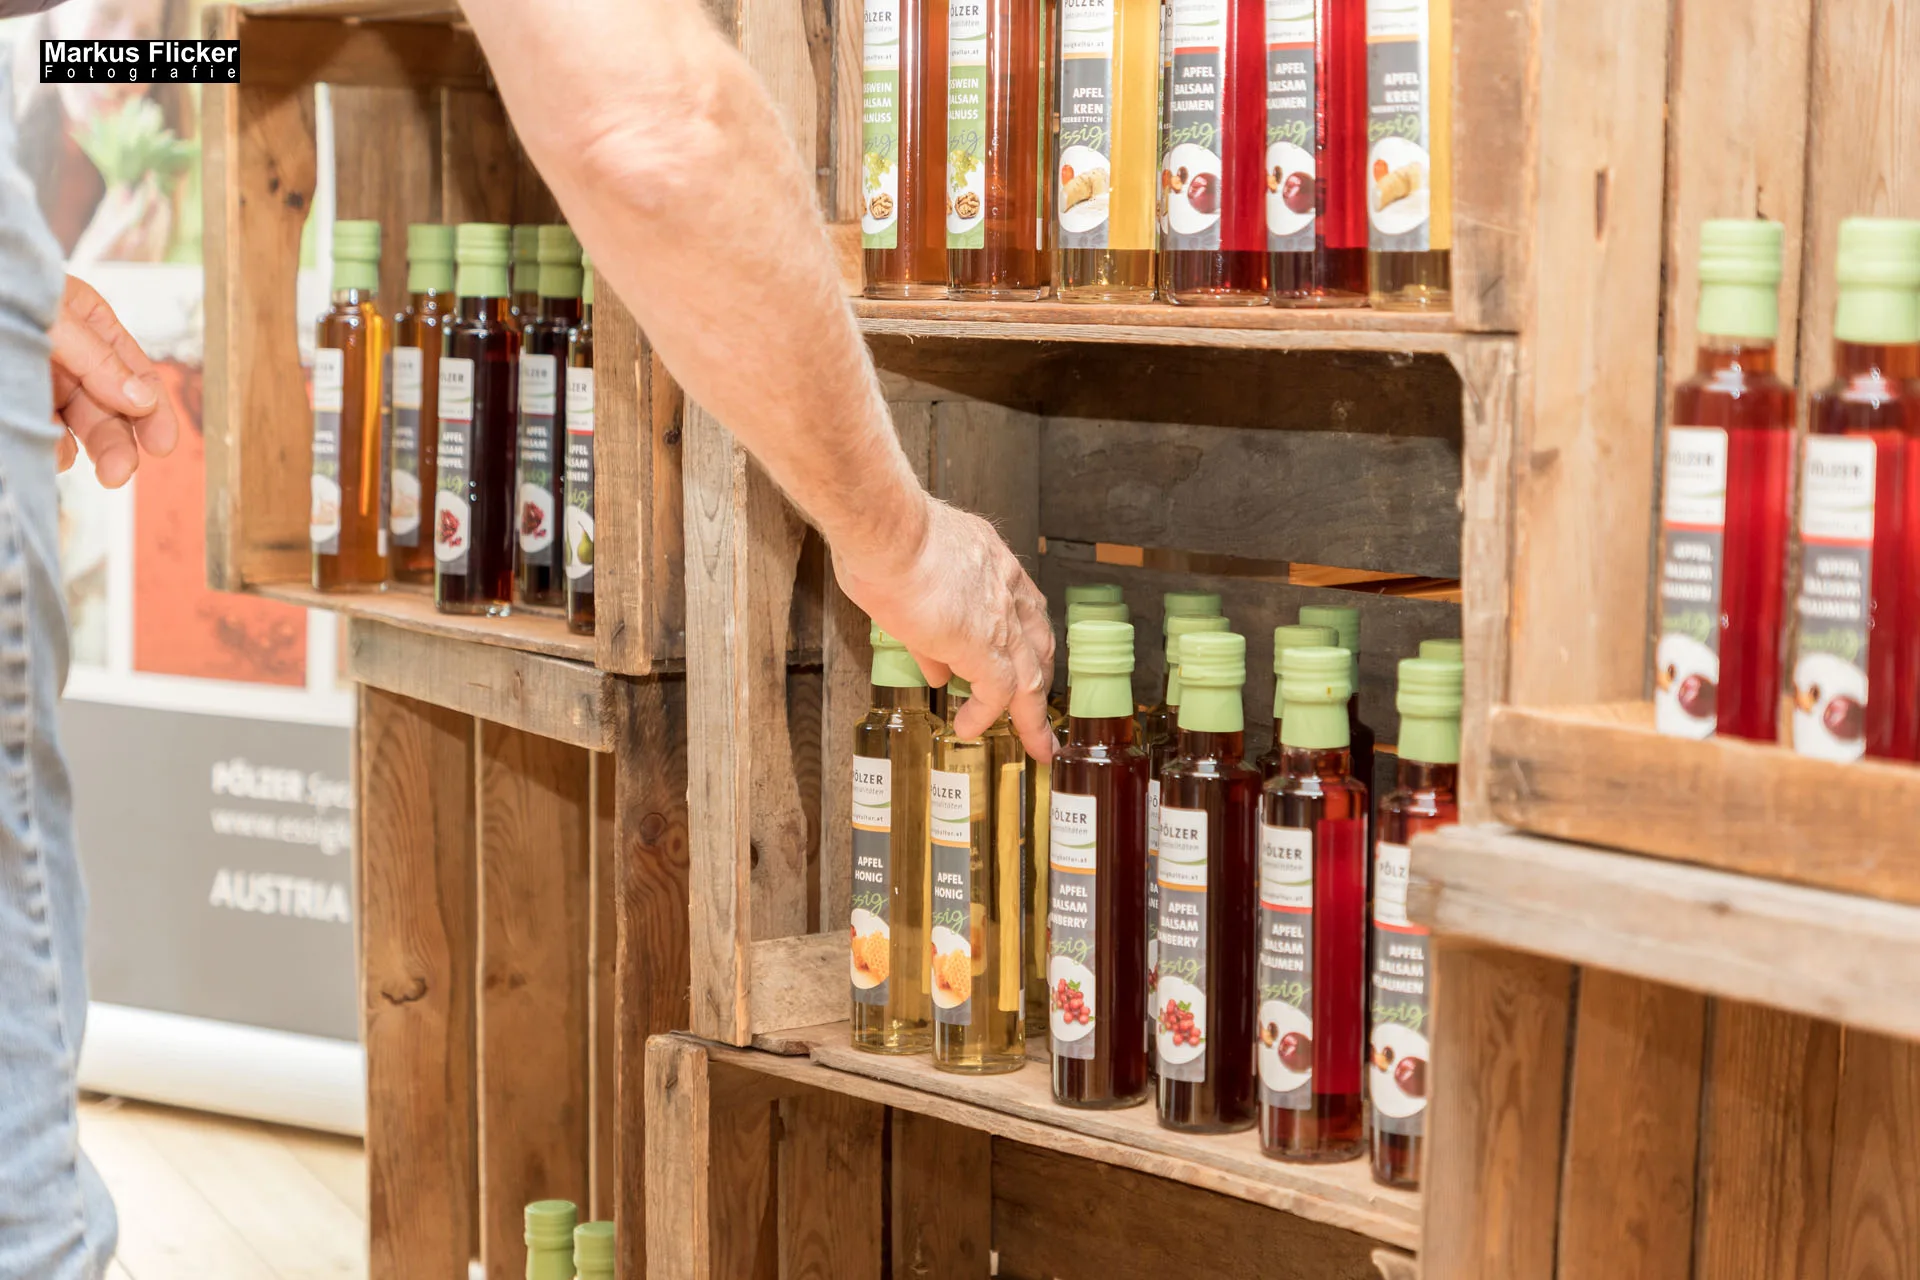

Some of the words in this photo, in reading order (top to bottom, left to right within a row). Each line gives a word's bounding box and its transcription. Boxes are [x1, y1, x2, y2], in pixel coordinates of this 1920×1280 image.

[1183, 66, 1215, 78] APFEL
[1275, 62, 1307, 75] APFEL
[1384, 72, 1419, 86] APFEL
[1072, 87, 1105, 99] APFEL
[1174, 83, 1215, 95] BALSAM
[1386, 91, 1419, 104] KREN
[1073, 103, 1104, 114] KREN
[853, 769, 884, 785] ÖLZER
[857, 856, 884, 868] APFEL
[854, 869, 883, 883] HONIG
[937, 872, 964, 885] APFEL
[209, 867, 350, 924] AUSTRIA
[934, 886, 964, 900] HONIG
[1060, 884, 1088, 898] APFEL
[1168, 902, 1199, 916] APFEL
[1272, 923, 1304, 939] APFEL
[1389, 945, 1425, 961] APFEL
